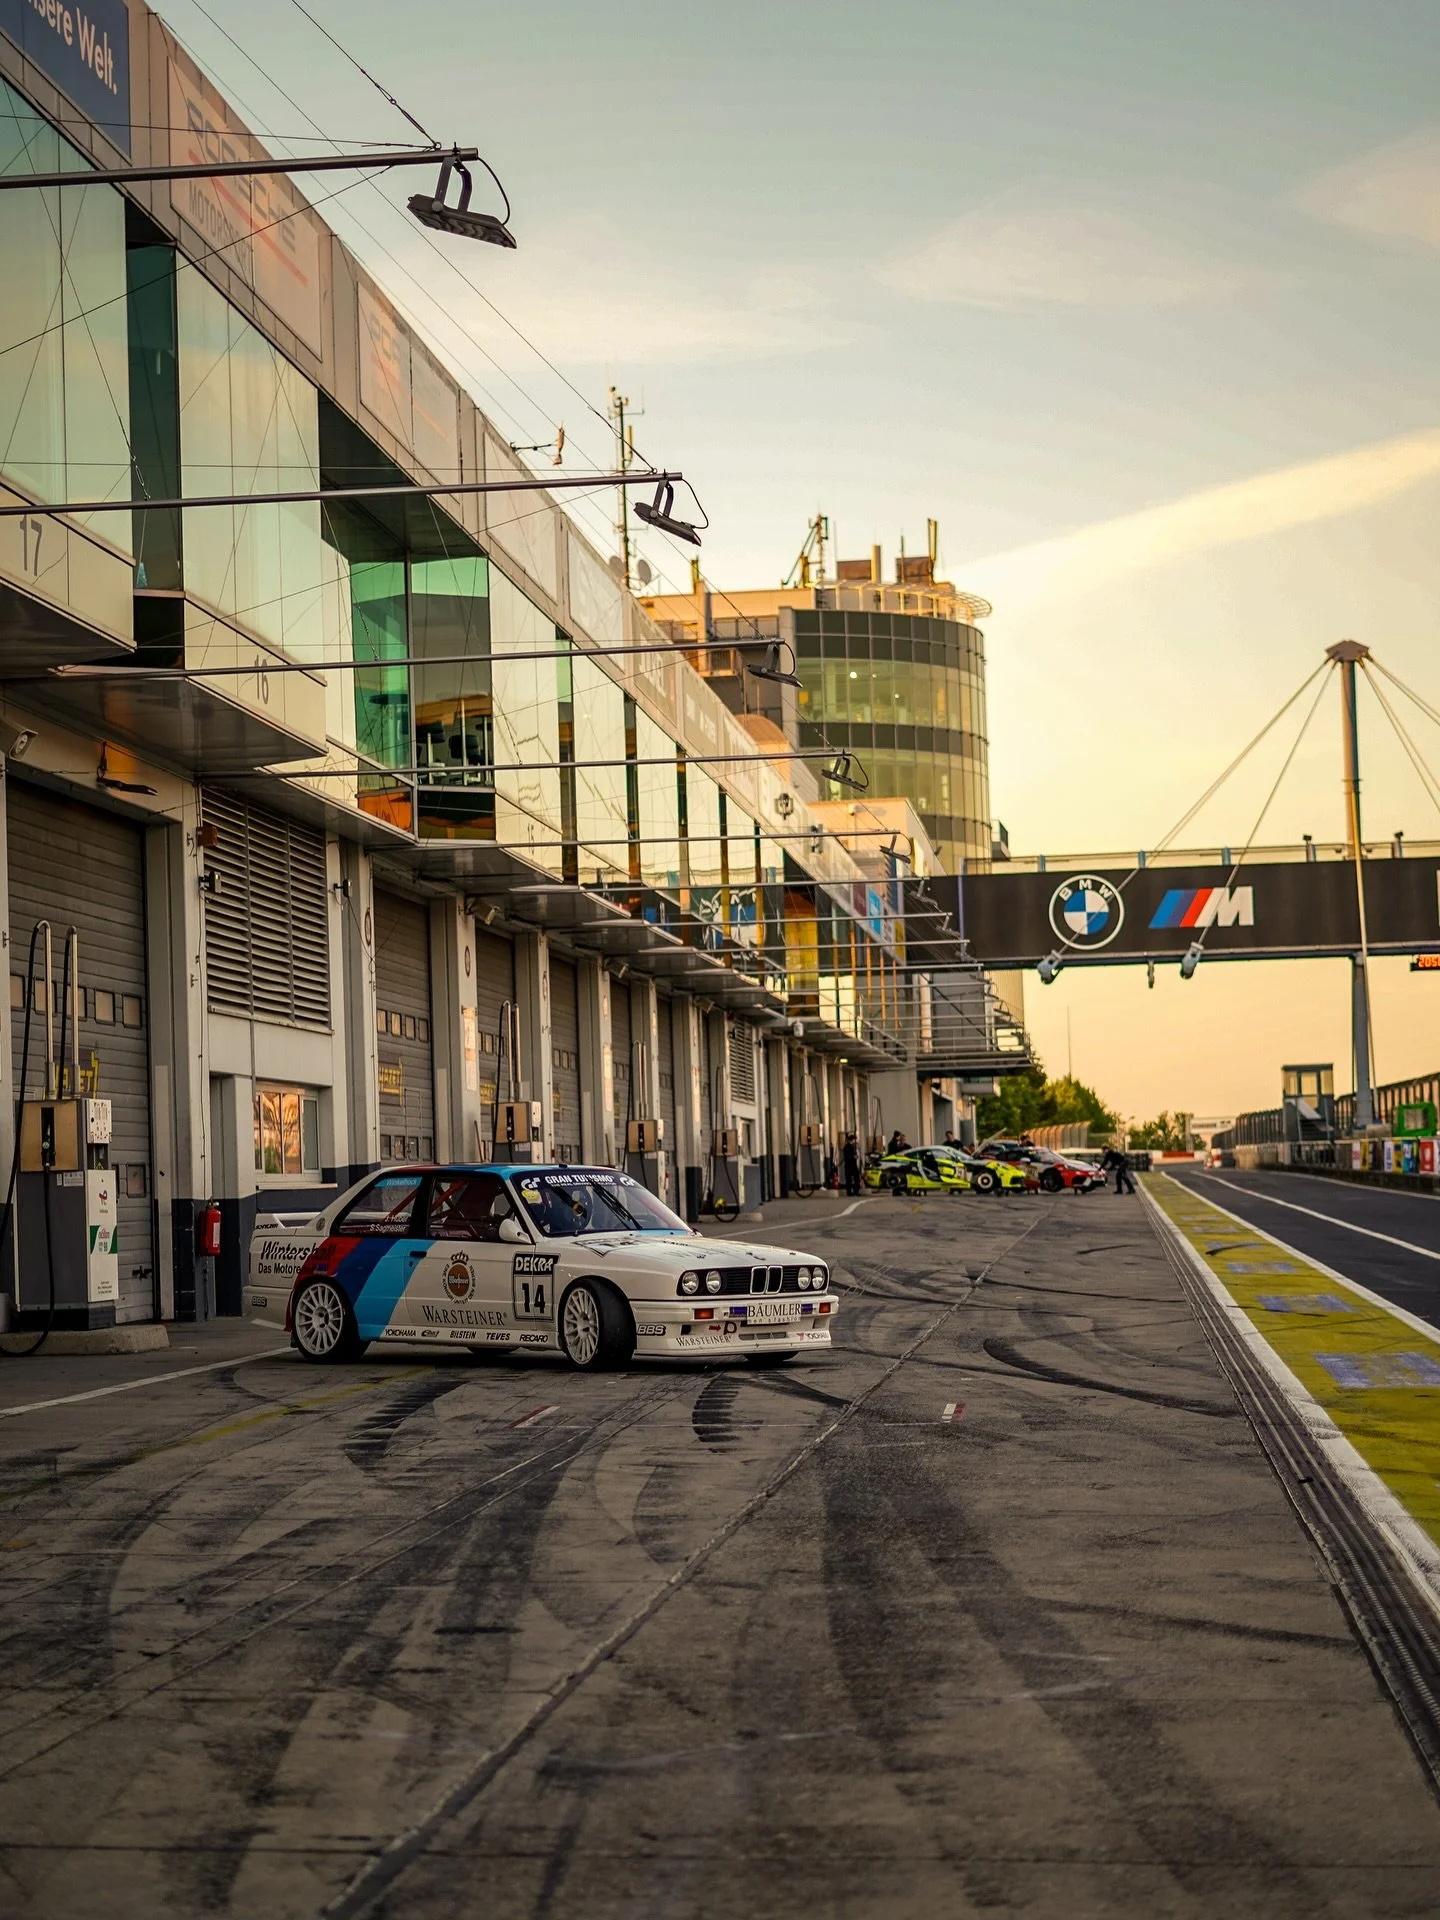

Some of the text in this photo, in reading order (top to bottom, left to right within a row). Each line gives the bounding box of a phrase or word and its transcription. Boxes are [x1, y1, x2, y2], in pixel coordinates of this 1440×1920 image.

[29, 0, 118, 95] sere Welt.
[187, 98, 296, 254] PORSCHE
[19, 513, 43, 577] 17
[253, 654, 270, 705] 16
[1059, 879, 1113, 902] BMW
[544, 1174, 572, 1185] GRAN
[258, 1263, 272, 1274] Das
[515, 1256, 554, 1272] DEKRA
[521, 1282, 546, 1315] 14
[747, 1302, 802, 1317] BÄUMLER
[384, 1328, 417, 1337] YOKOHAMA
[449, 1330, 477, 1340] BILSTEIN
[485, 1332, 512, 1341] TEVES
[637, 1324, 665, 1336] BBS
[518, 1333, 549, 1343] RECARO
